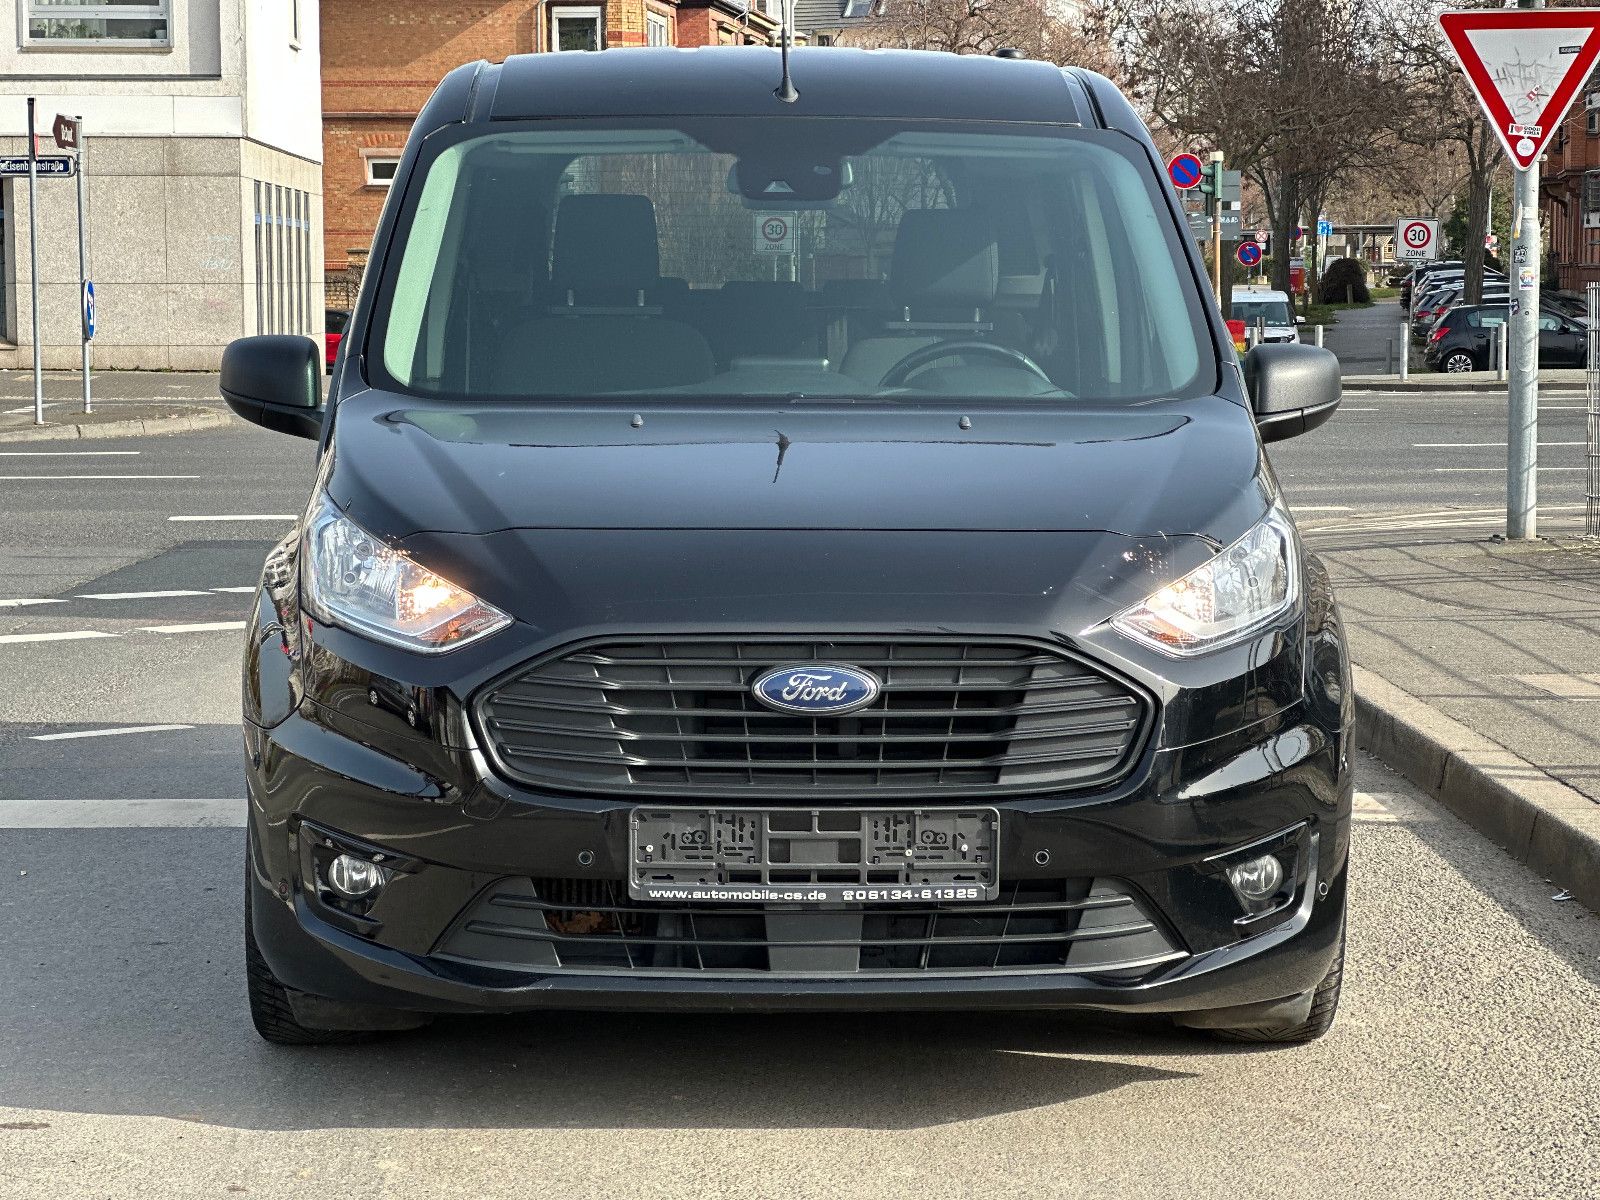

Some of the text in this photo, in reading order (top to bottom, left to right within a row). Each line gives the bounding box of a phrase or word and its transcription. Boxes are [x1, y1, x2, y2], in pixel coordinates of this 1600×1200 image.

[5, 161, 64, 172] Eisenbnstraße
[767, 224, 783, 235] 30
[1409, 228, 1426, 242] 30
[782, 673, 848, 701] Ford
[649, 889, 827, 900] www.automobile-cs.de
